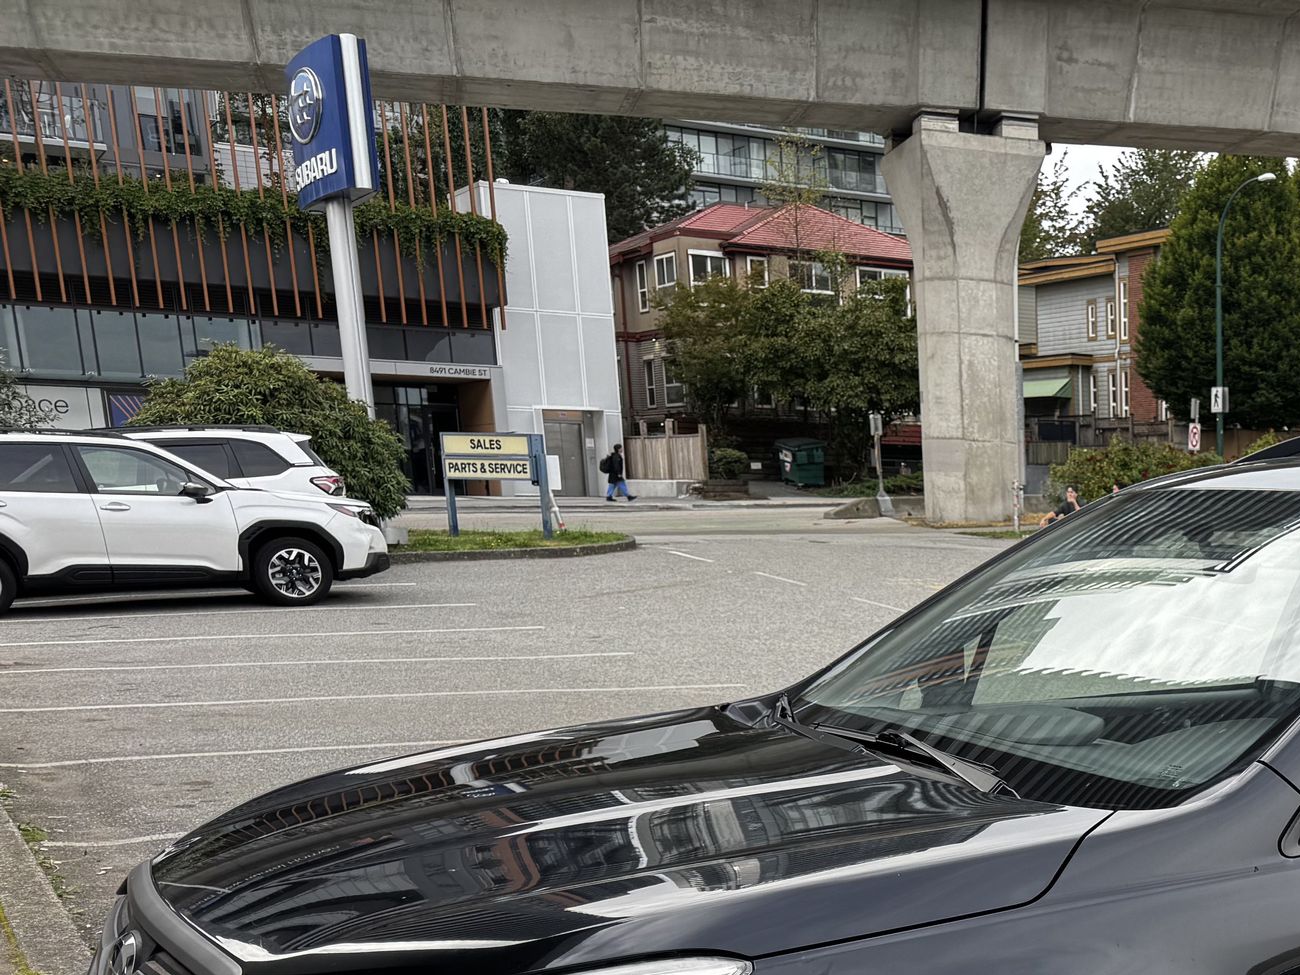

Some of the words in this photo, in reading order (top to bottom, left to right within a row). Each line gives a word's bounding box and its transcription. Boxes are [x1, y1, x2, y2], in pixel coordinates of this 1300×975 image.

[295, 148, 338, 191] SUBARU
[429, 366, 447, 375] 8491
[447, 367, 477, 376] CAMBIE
[478, 369, 488, 377] ST
[470, 439, 502, 450] SALES
[448, 462, 478, 473] PARTS
[480, 463, 487, 474] &
[488, 463, 528, 474] SERVICE
